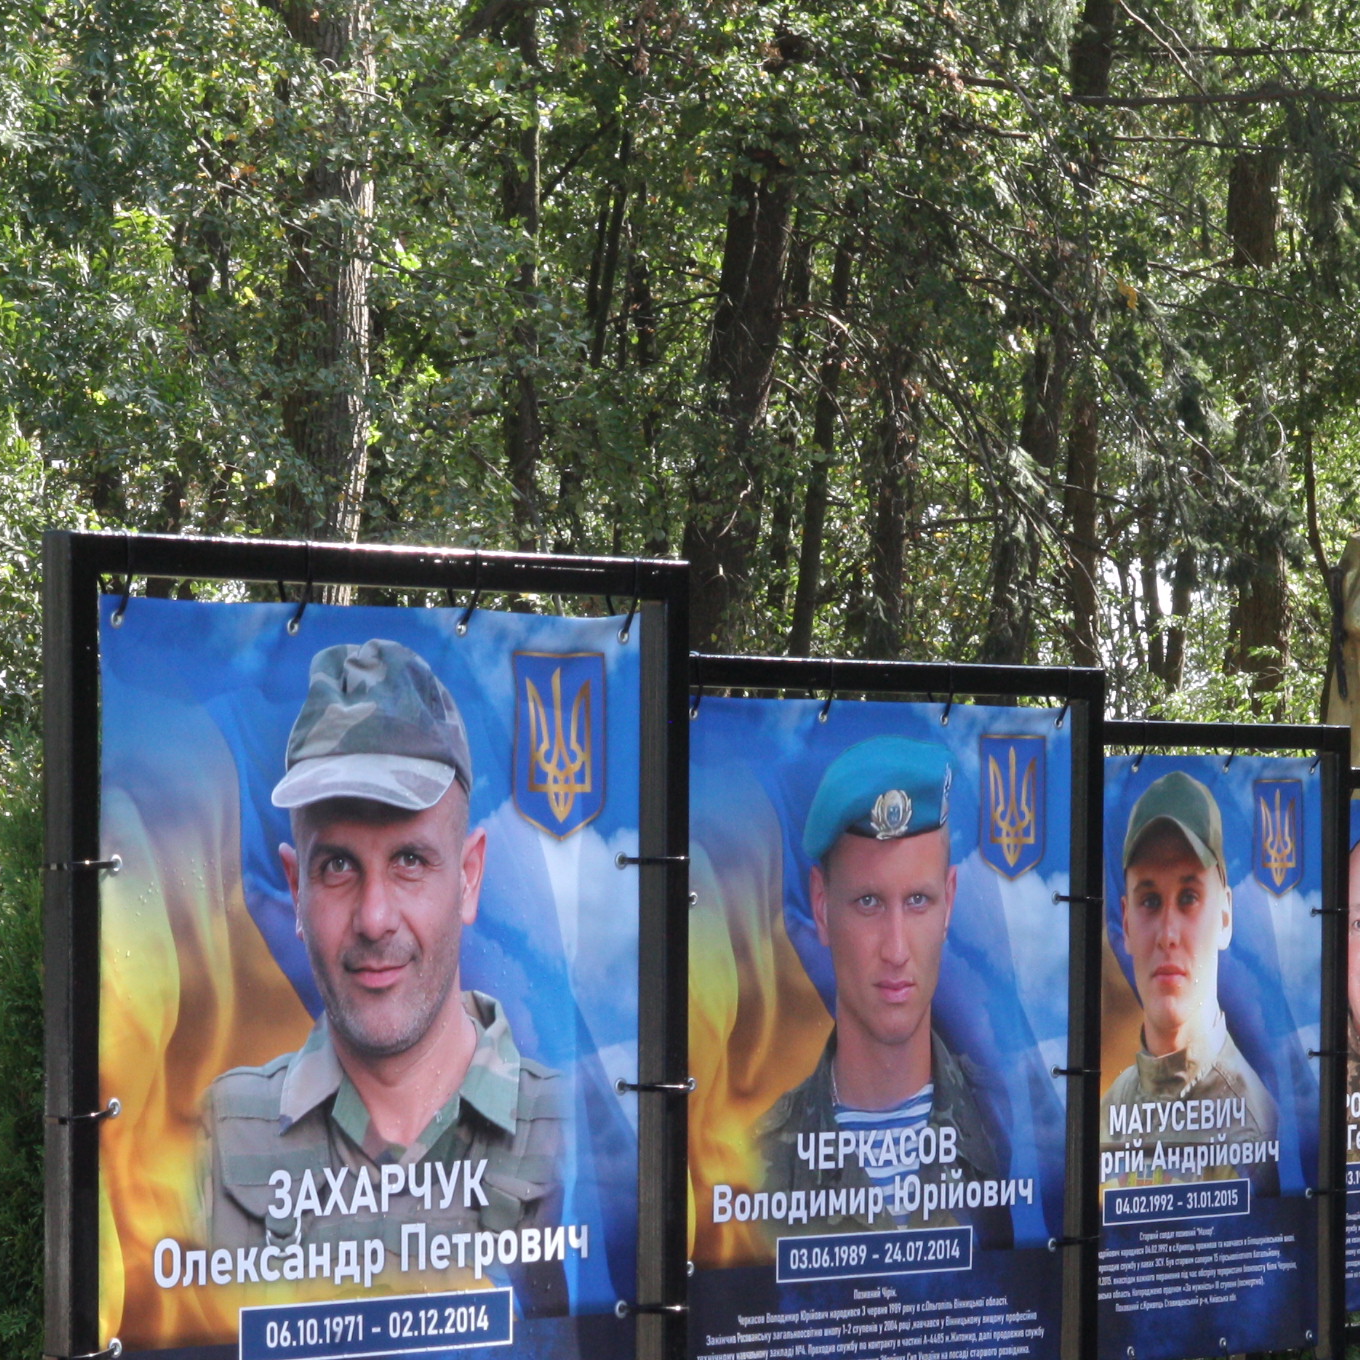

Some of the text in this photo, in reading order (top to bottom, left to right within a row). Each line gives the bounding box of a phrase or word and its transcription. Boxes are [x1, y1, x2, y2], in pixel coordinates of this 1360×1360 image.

[1109, 1098, 1246, 1136] МАТУСЕВИЧ
[797, 1127, 958, 1170] ЧЕРКАСОВ
[1152, 1133, 1280, 1175] Андрійович
[268, 1159, 490, 1219] ЗАХАРЧУК
[713, 1169, 1033, 1224] Володимир Юрійович
[1116, 1194, 1173, 1214] 04.02.1992
[1187, 1190, 1238, 1209] 31.01.2015
[154, 1223, 589, 1288] Олександр Петрович
[790, 1245, 867, 1270] 03.06.1989
[884, 1239, 960, 1264] 24.07.2014
[266, 1315, 365, 1349] 06.10.1971
[389, 1306, 489, 1338] 02.12.2014
